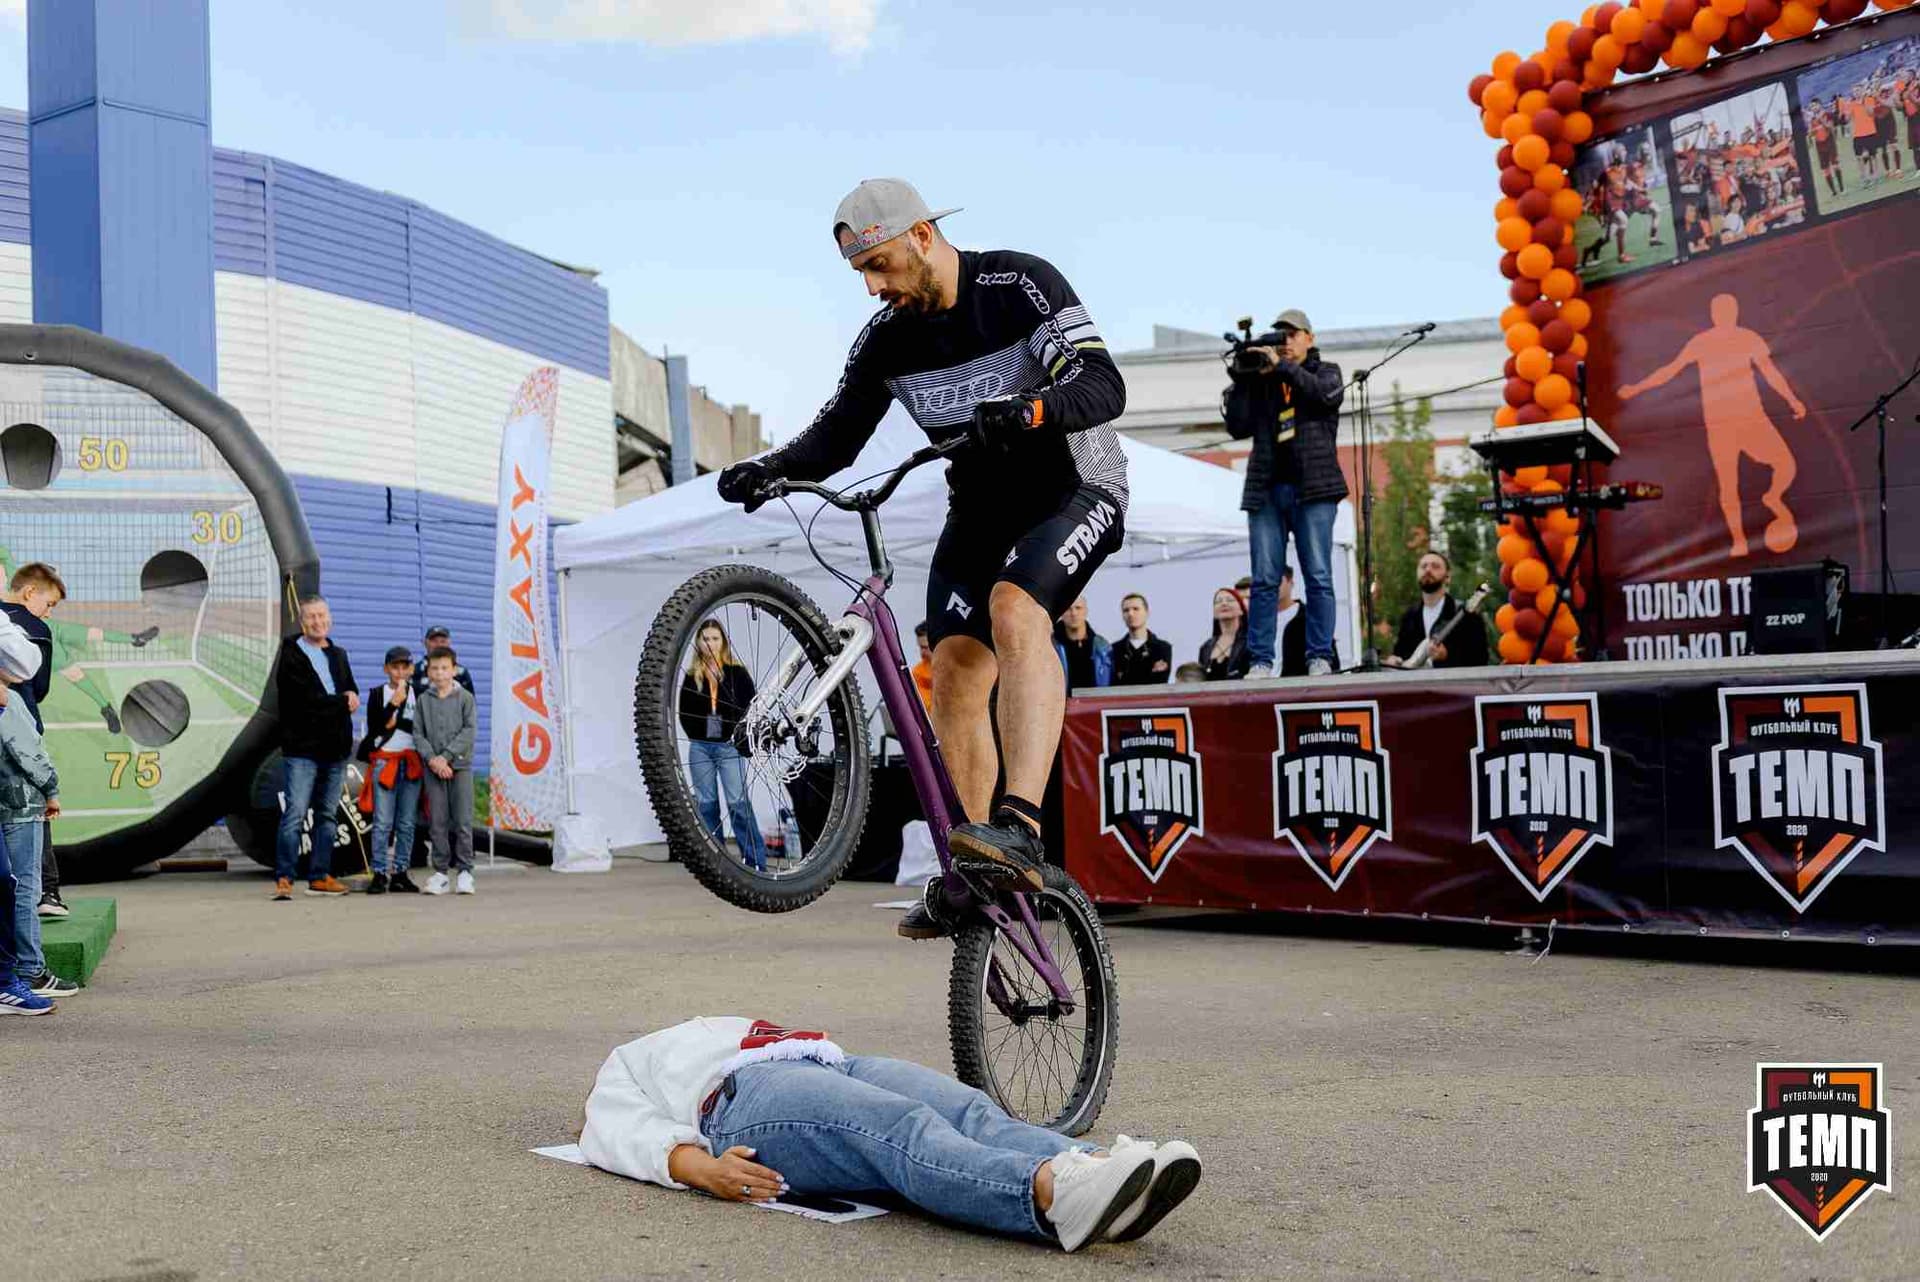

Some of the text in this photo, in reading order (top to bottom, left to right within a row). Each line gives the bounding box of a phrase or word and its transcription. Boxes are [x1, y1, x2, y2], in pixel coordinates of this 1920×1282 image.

[79, 437, 129, 472] 50
[191, 510, 243, 545] 30
[1056, 500, 1116, 575] STRAVA
[509, 462, 552, 776] GALAXY
[1622, 578, 1721, 622] ТОЛЬКО
[1624, 632, 1723, 661] ТОЛЬКО
[1750, 719, 1838, 736] ФУТБОЛЬНЫЙ КЛУБ
[104, 751, 162, 789] 75
[1109, 758, 1193, 817] ТЕМП
[1284, 755, 1379, 820] ТЕМП
[1484, 752, 1597, 823] ТЕМП
[1729, 749, 1867, 826] ТЕМП
